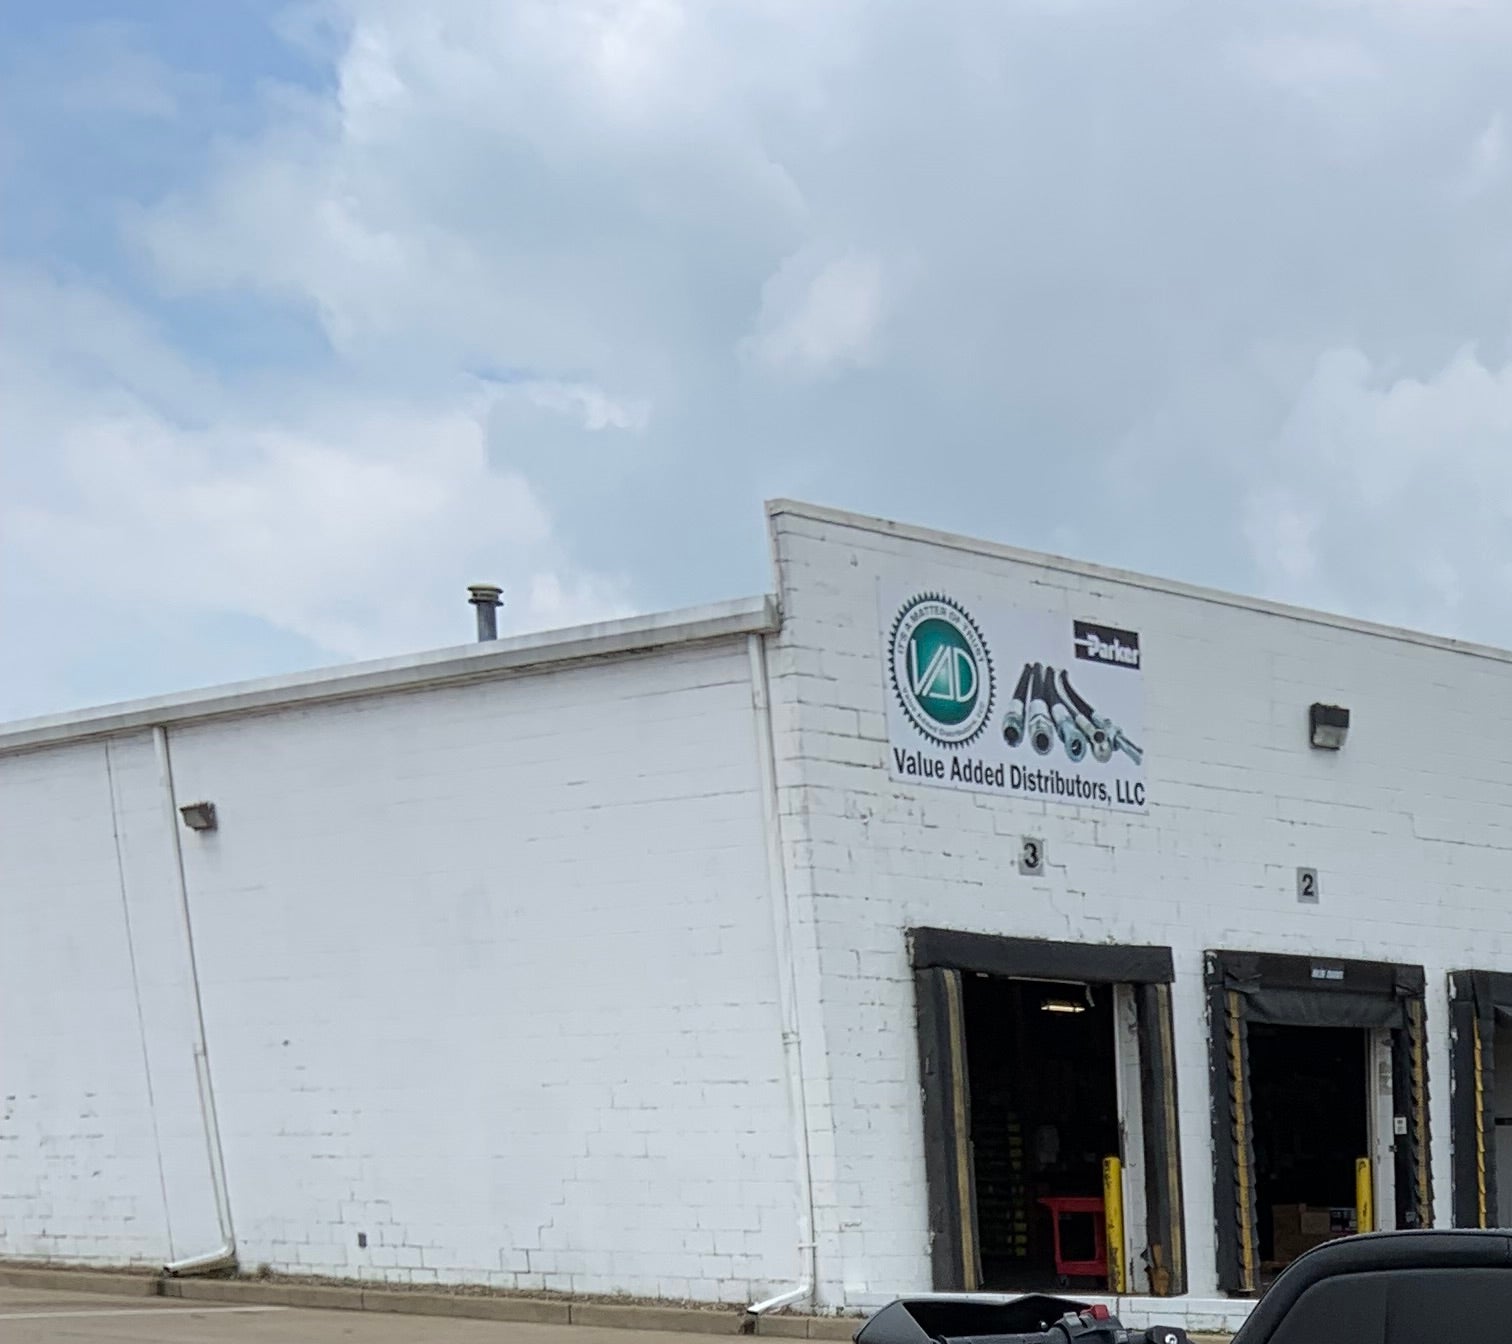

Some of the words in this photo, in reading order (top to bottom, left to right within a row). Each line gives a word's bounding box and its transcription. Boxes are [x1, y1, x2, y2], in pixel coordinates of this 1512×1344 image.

[1085, 633, 1140, 665] Parker
[893, 747, 945, 779] Value
[950, 756, 1005, 788] Added
[1010, 764, 1112, 806] Distributors,
[1116, 779, 1146, 806] LLC
[1023, 842, 1039, 868] 3
[1302, 873, 1314, 897] 2
